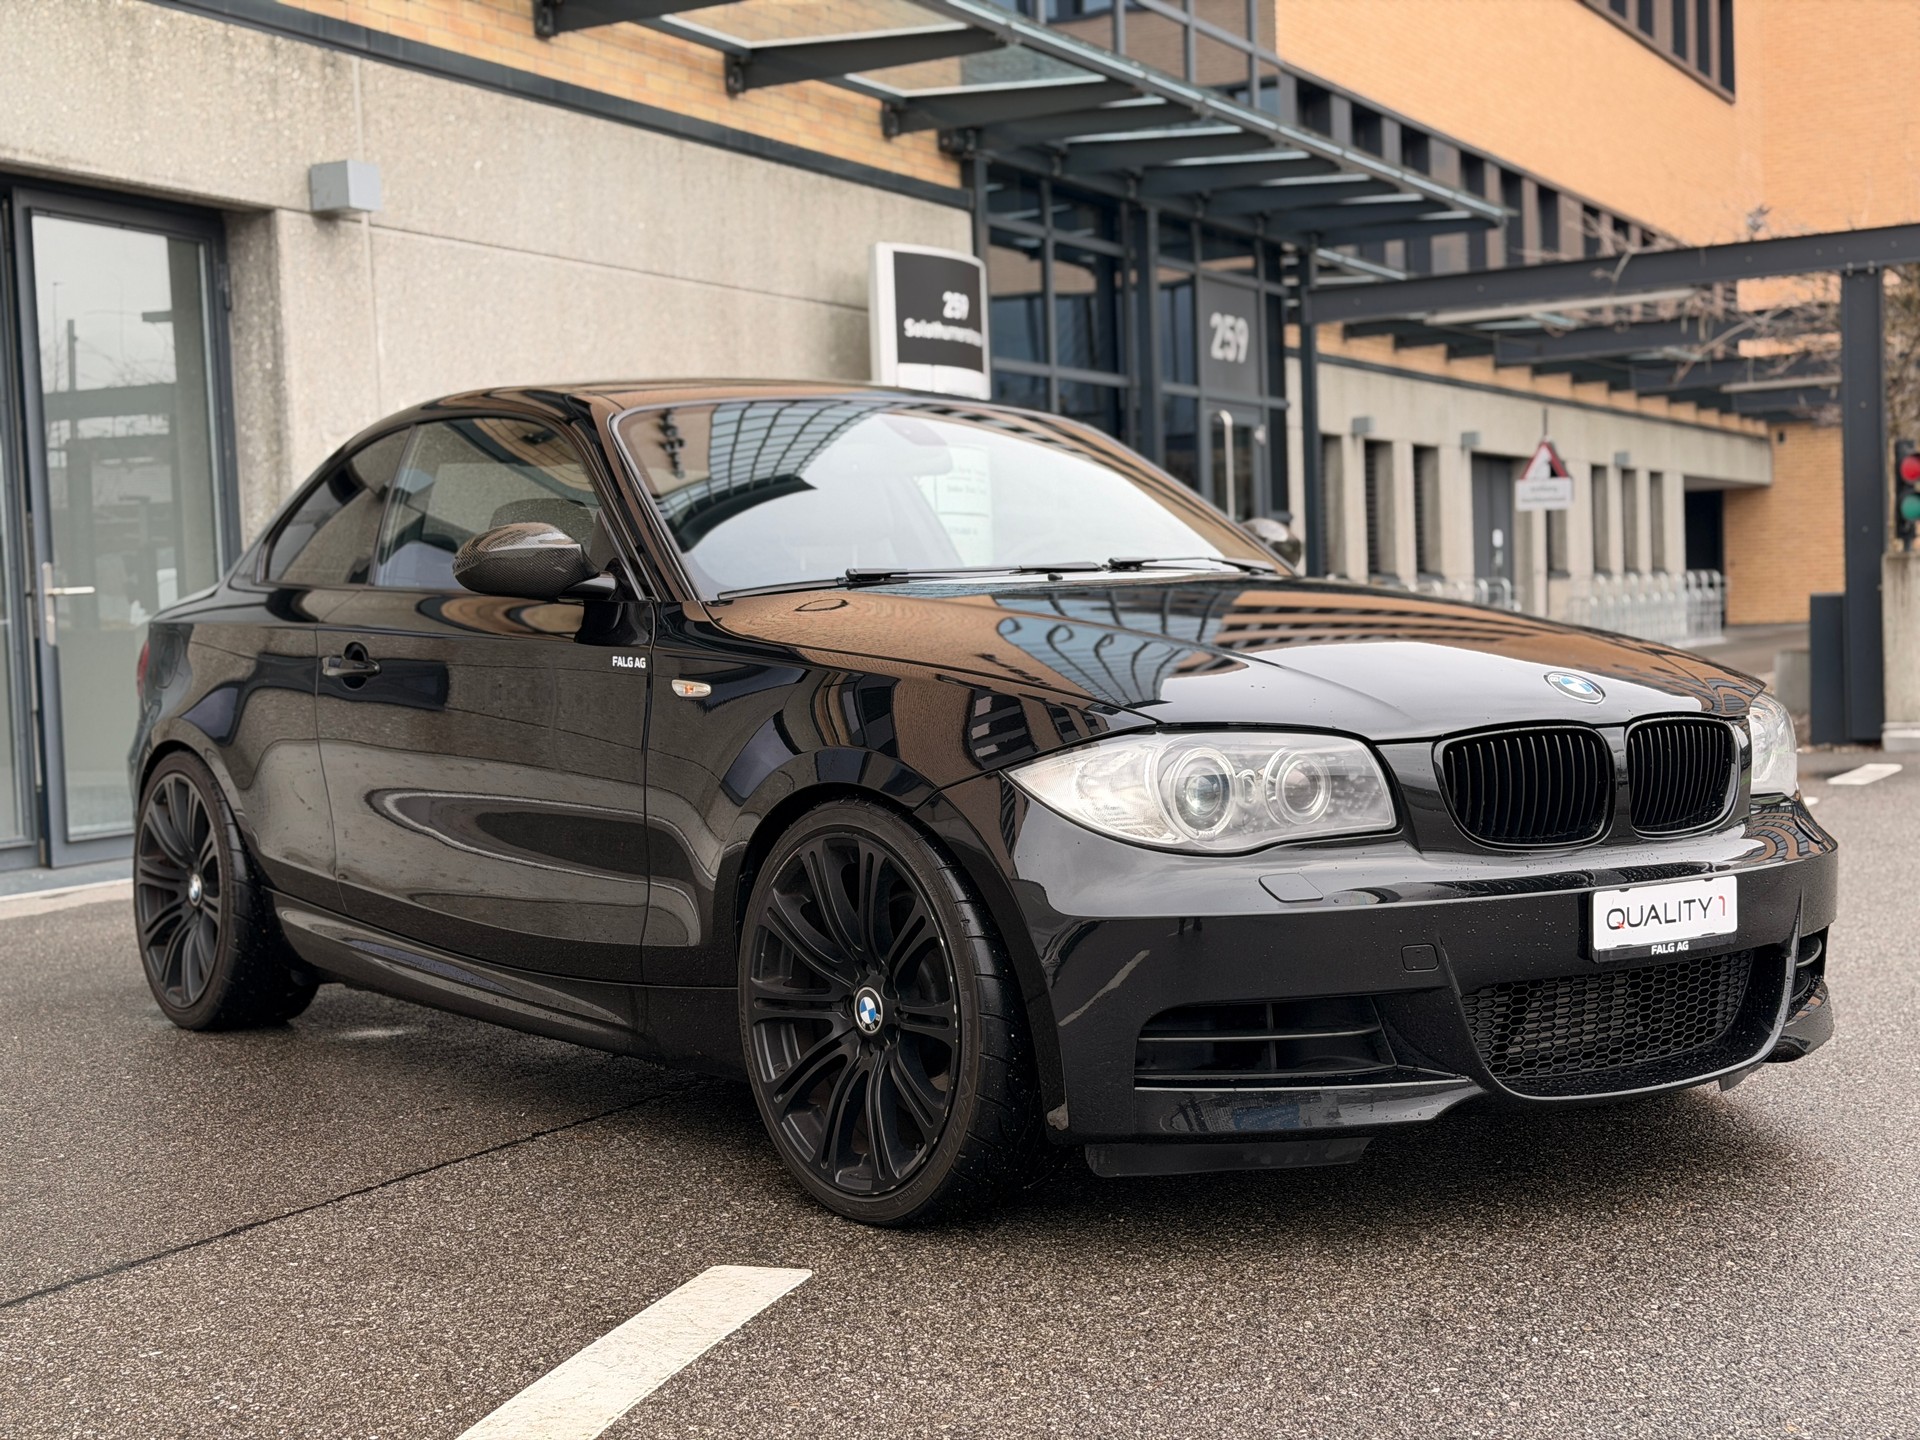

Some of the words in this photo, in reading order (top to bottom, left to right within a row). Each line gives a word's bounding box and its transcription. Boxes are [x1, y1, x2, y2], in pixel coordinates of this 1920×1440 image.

[943, 292, 969, 319] 259
[1210, 312, 1249, 364] 259
[612, 655, 633, 668] FALG
[634, 657, 646, 669] AG
[1651, 943, 1675, 955] FALG
[1676, 941, 1689, 952] AG
